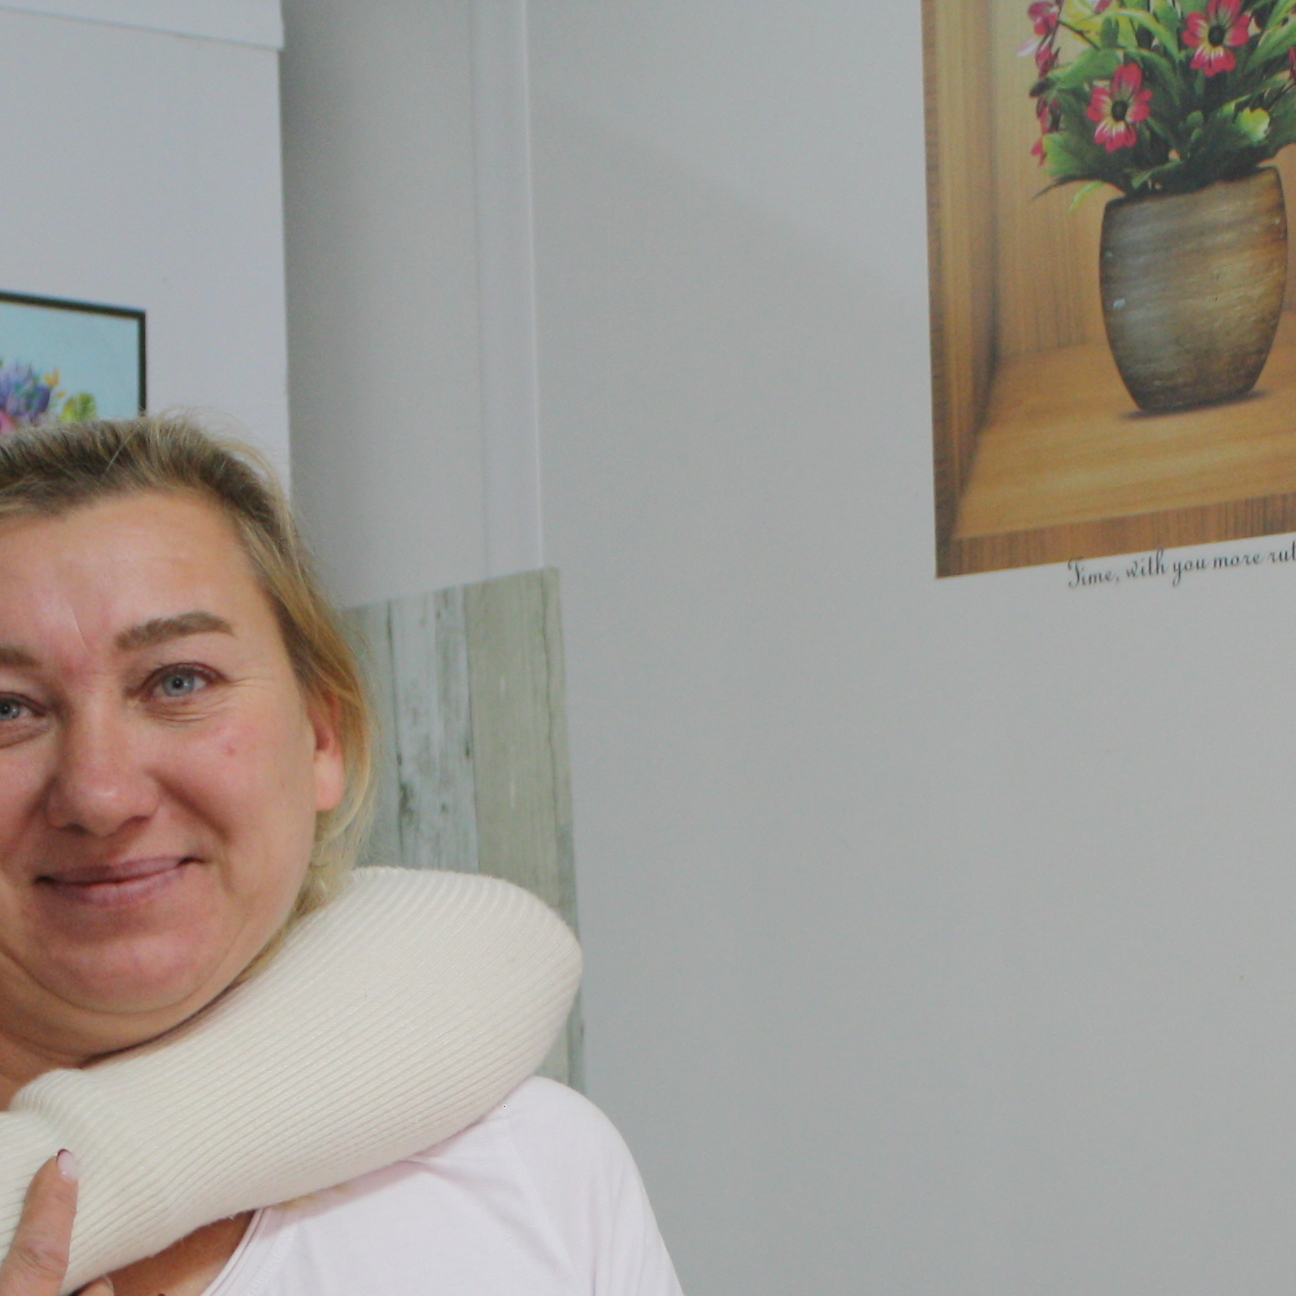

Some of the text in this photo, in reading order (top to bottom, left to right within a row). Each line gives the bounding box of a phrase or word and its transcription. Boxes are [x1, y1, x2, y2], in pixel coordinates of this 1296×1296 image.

[1067, 557, 1120, 587] Time,
[1126, 548, 1167, 578] with
[1172, 558, 1207, 587] you
[1213, 552, 1262, 569] more
